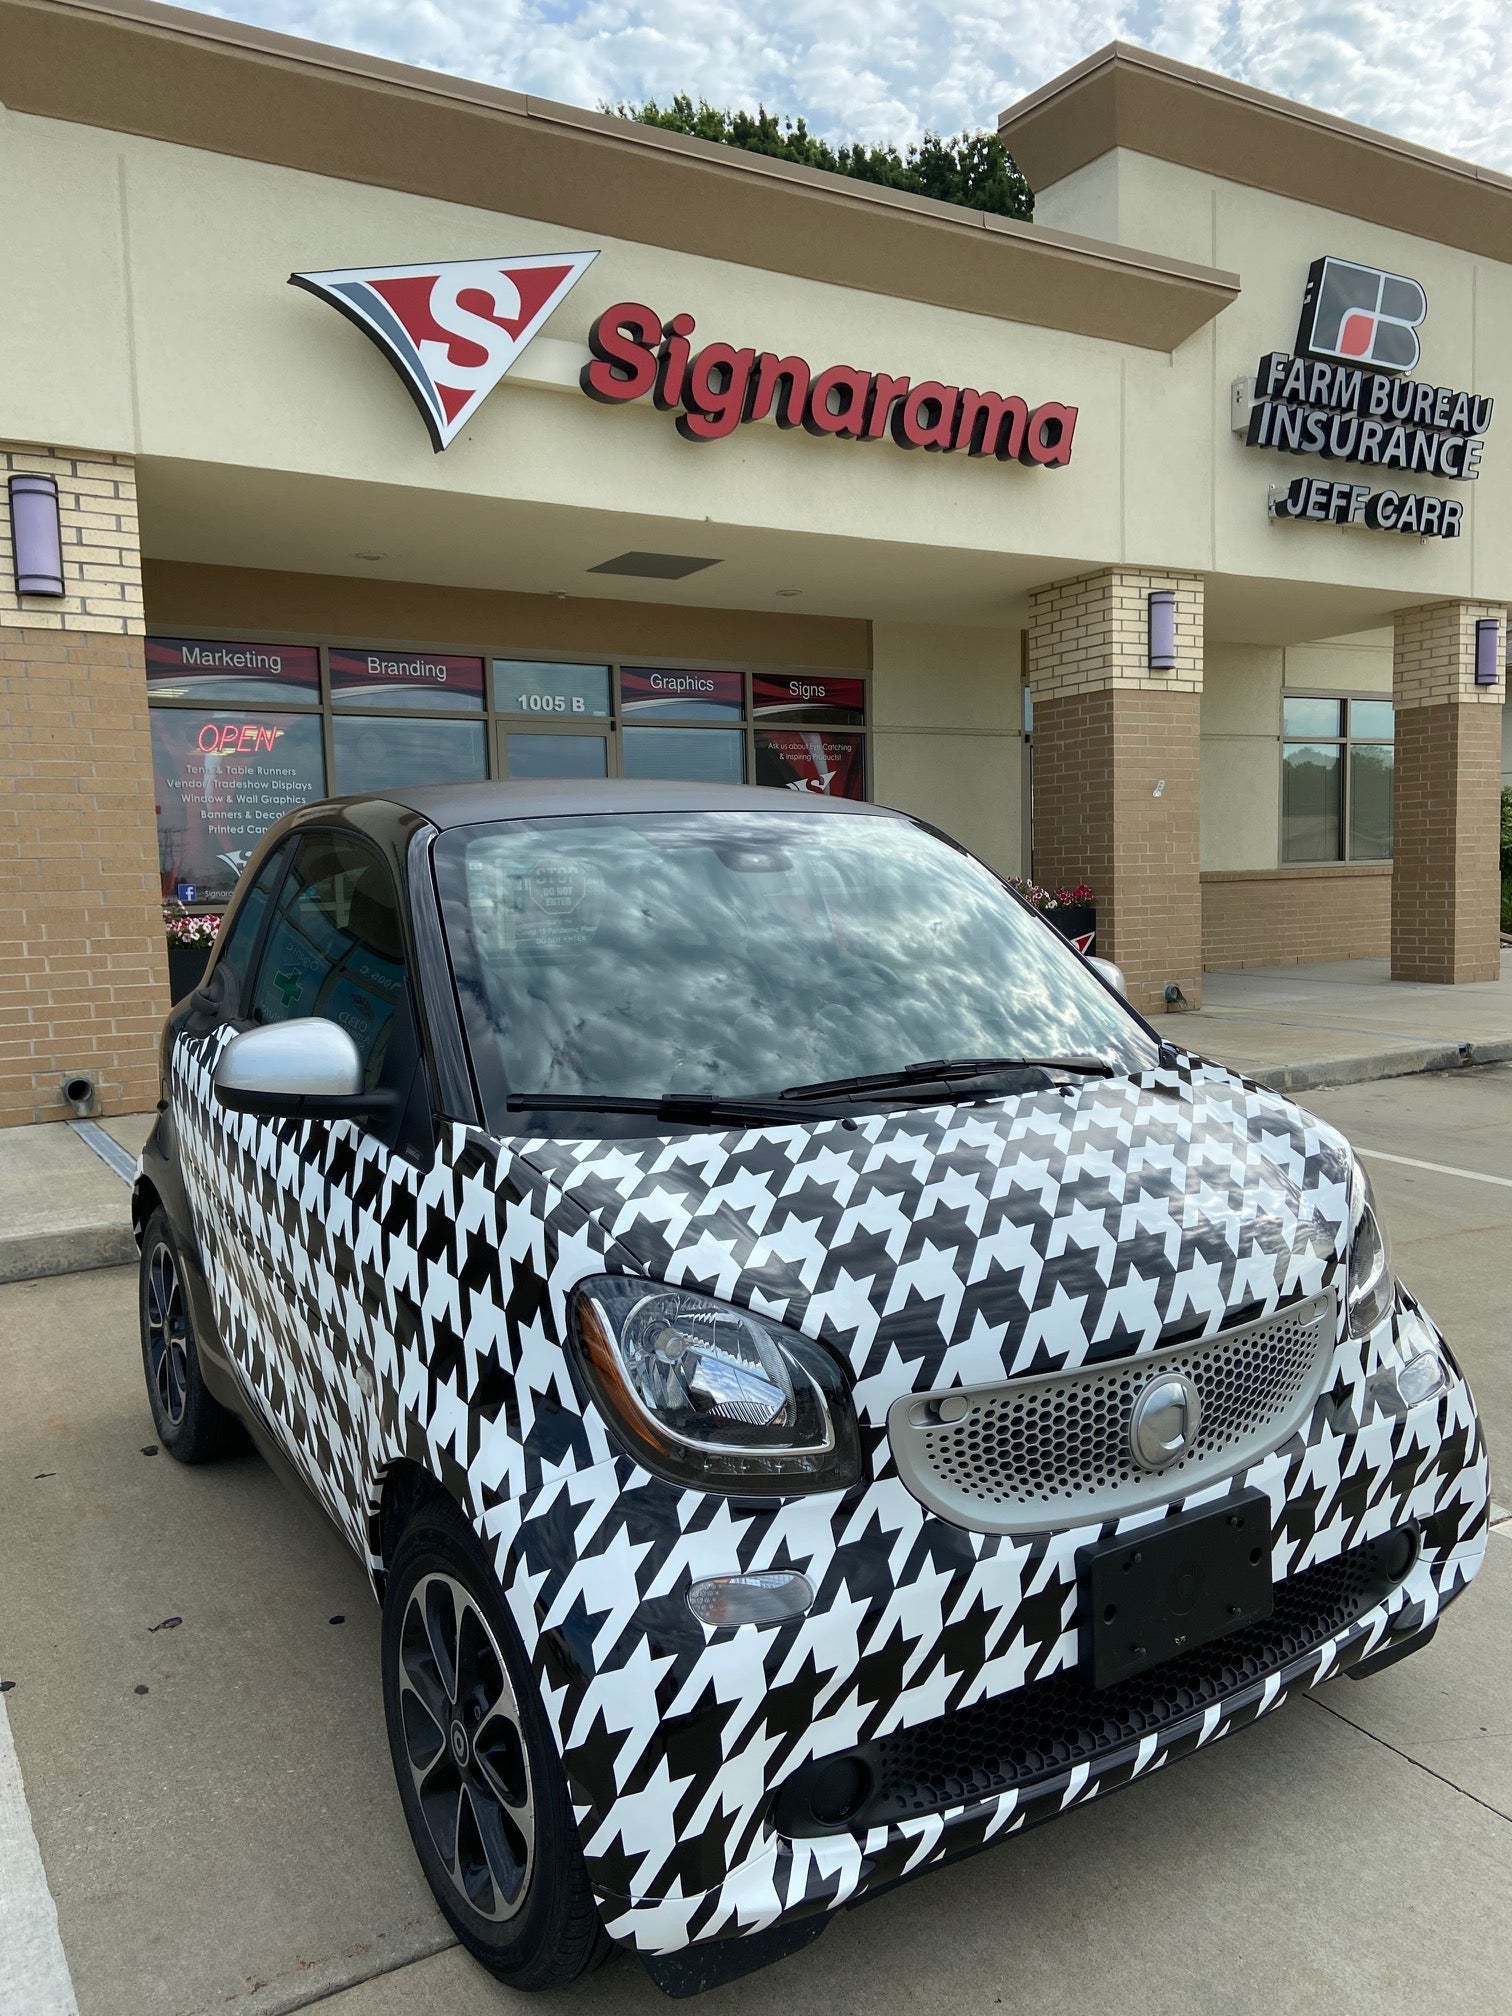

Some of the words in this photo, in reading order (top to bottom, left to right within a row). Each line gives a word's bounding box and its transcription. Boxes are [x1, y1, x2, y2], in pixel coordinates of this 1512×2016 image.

[580, 302, 1079, 469] Signarama
[1257, 352, 1363, 412] FARM
[1362, 373, 1494, 436] BUREAU
[1248, 401, 1484, 480] INSURANCE
[1276, 477, 1371, 523] JEFF
[1366, 489, 1464, 538] CARR
[181, 646, 282, 673] Marketing
[367, 657, 447, 682] Branding
[650, 673, 714, 693] Graphics
[789, 681, 825, 699] Signs
[518, 694, 565, 712] 1005
[572, 696, 585, 712] B
[198, 724, 277, 753] OPEN
[768, 742, 779, 750] Ask
[822, 743, 852, 753] Catching
[786, 753, 812, 762] Inspiring
[216, 765, 223, 775] &
[226, 765, 254, 775] Table
[257, 766, 296, 776] Runners
[213, 780, 268, 789] Tradeshow
[271, 780, 312, 792] Displays
[181, 793, 223, 803] Window
[226, 795, 233, 804] &
[236, 794, 258, 804] Wall
[260, 795, 306, 806] Graphics
[200, 810, 242, 819] Banners
[245, 810, 252, 819] &
[208, 825, 244, 834] Printed
